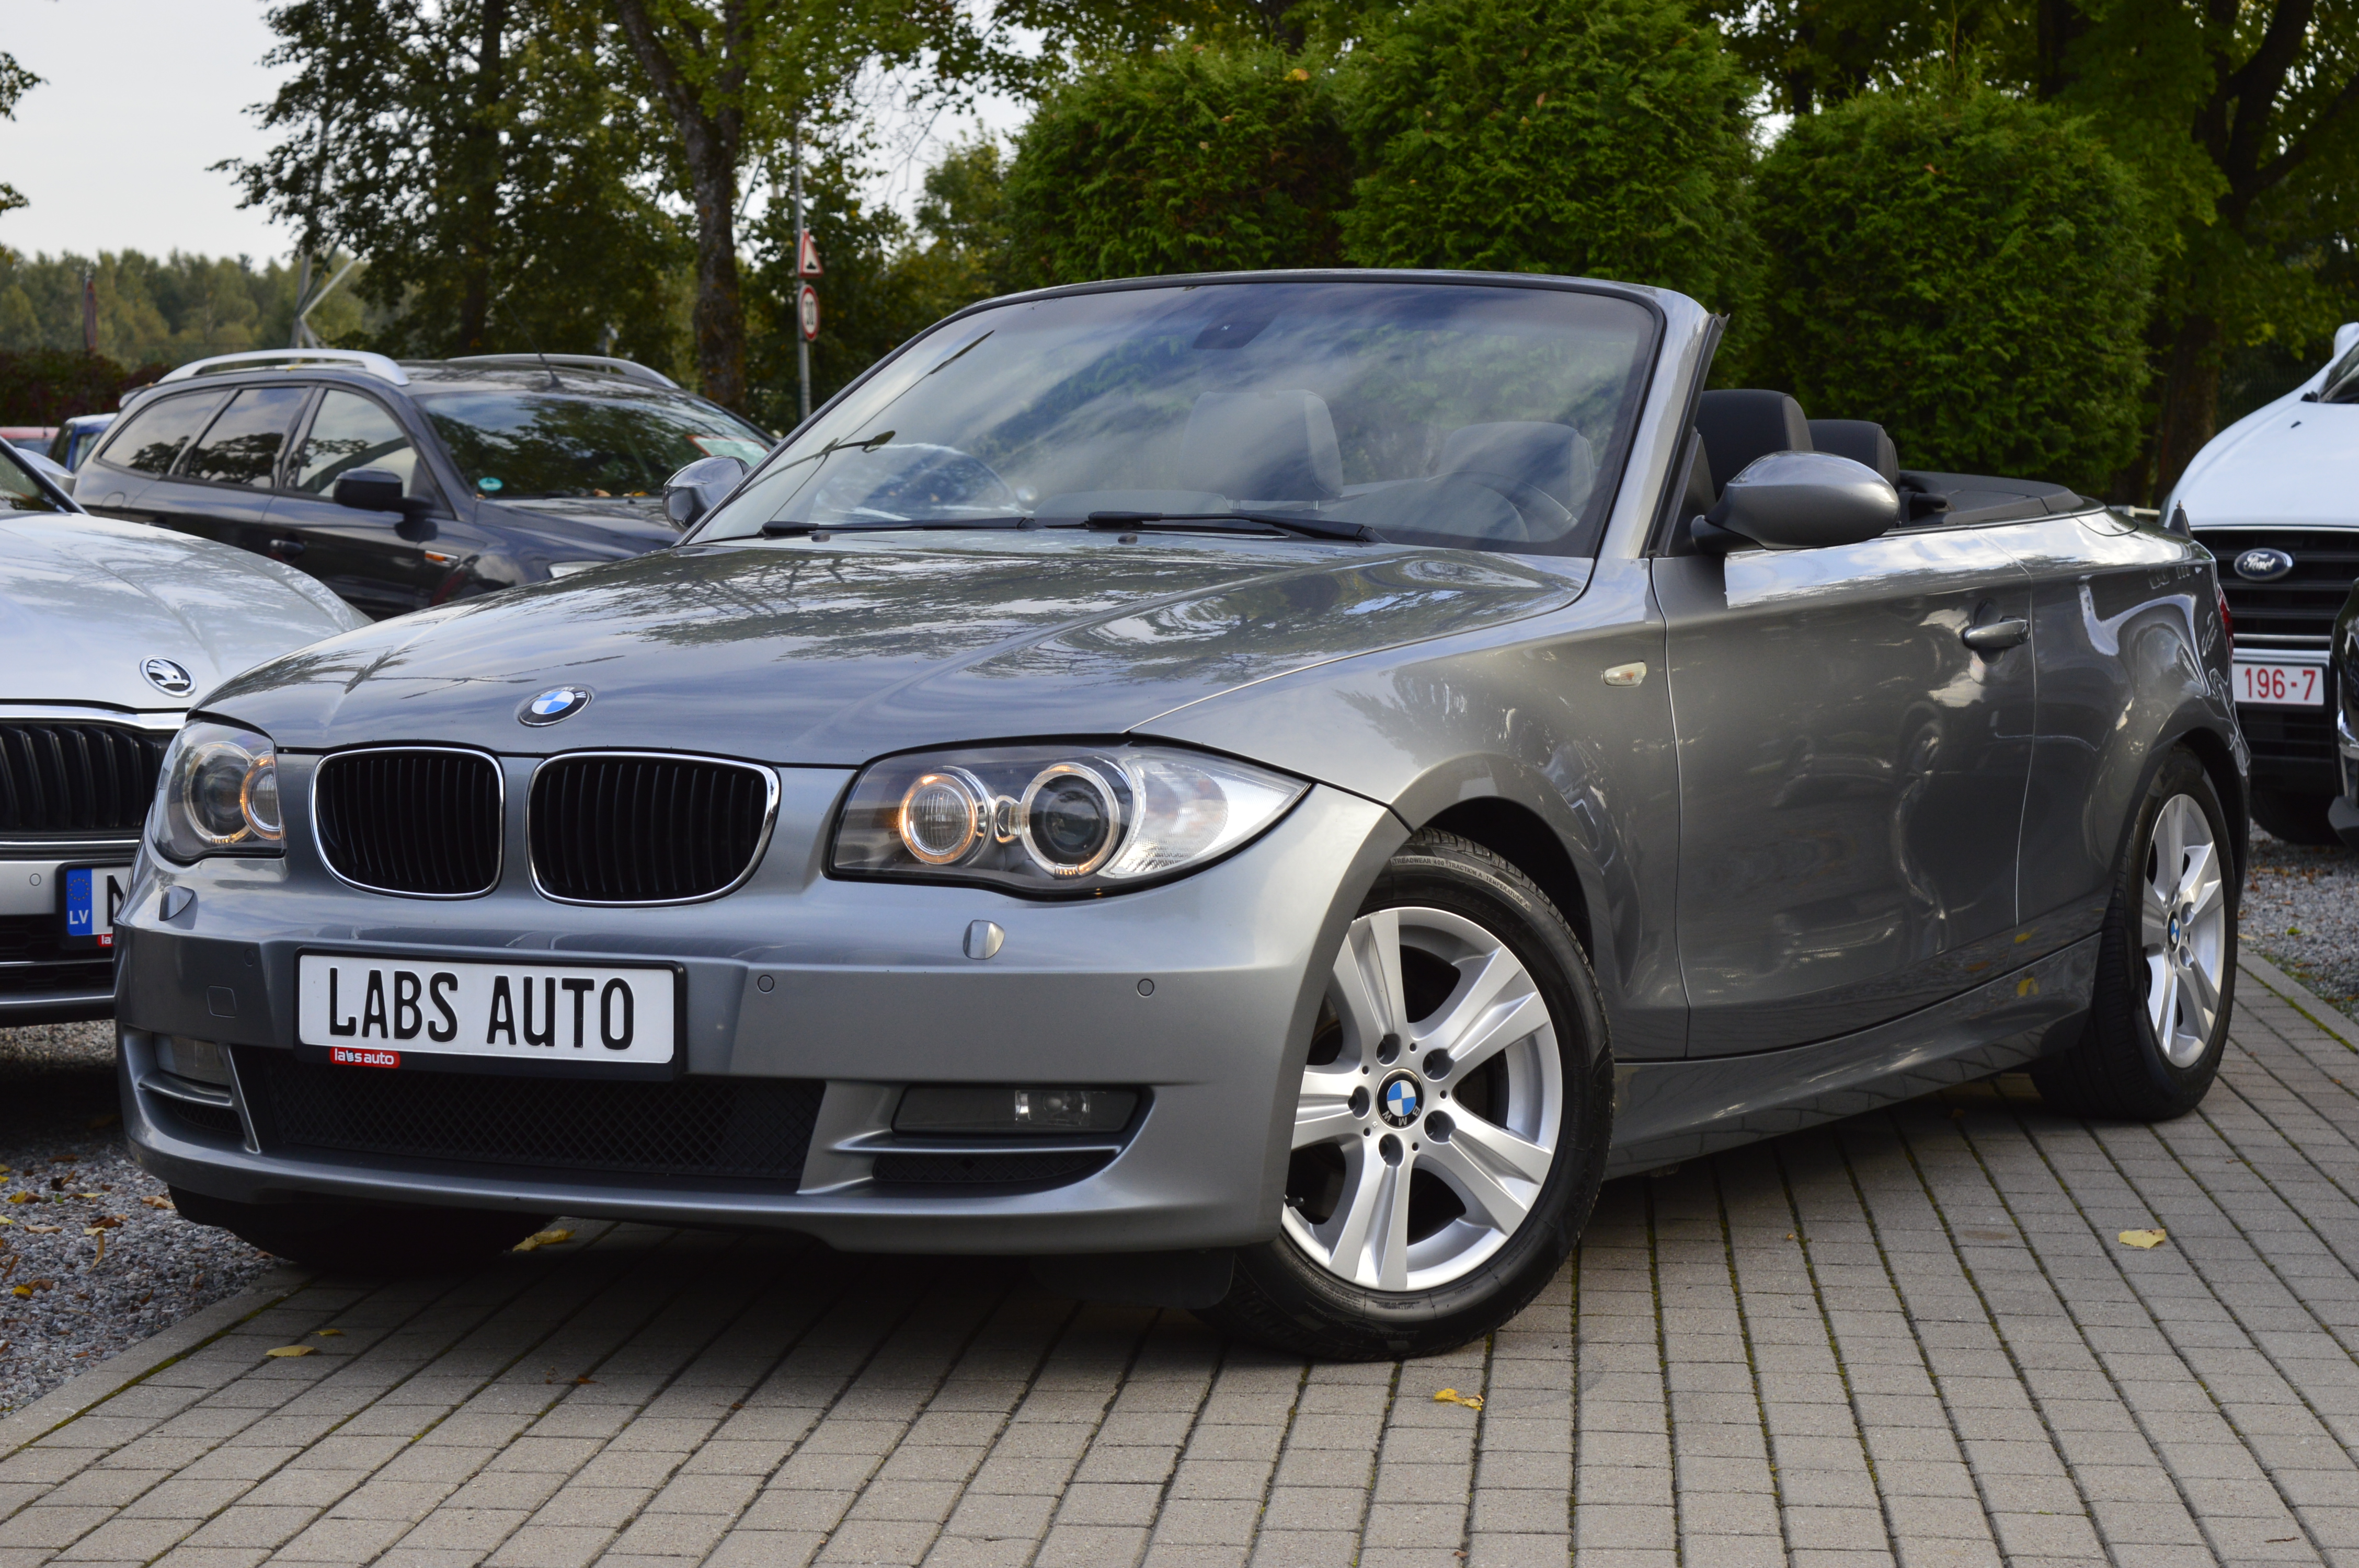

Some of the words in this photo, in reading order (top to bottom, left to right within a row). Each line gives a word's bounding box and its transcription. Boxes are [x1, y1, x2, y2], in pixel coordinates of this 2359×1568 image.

[2243, 552, 2275, 571] Ford
[1448, 861, 1477, 876] TRACTION
[1485, 875, 1524, 905] TEMPERATURE
[70, 909, 89, 925] LV
[101, 935, 113, 945] la
[329, 967, 459, 1043] LABS
[486, 975, 634, 1050] AUTO
[364, 1052, 395, 1065] auto
[1382, 1105, 1421, 1126] BMW
